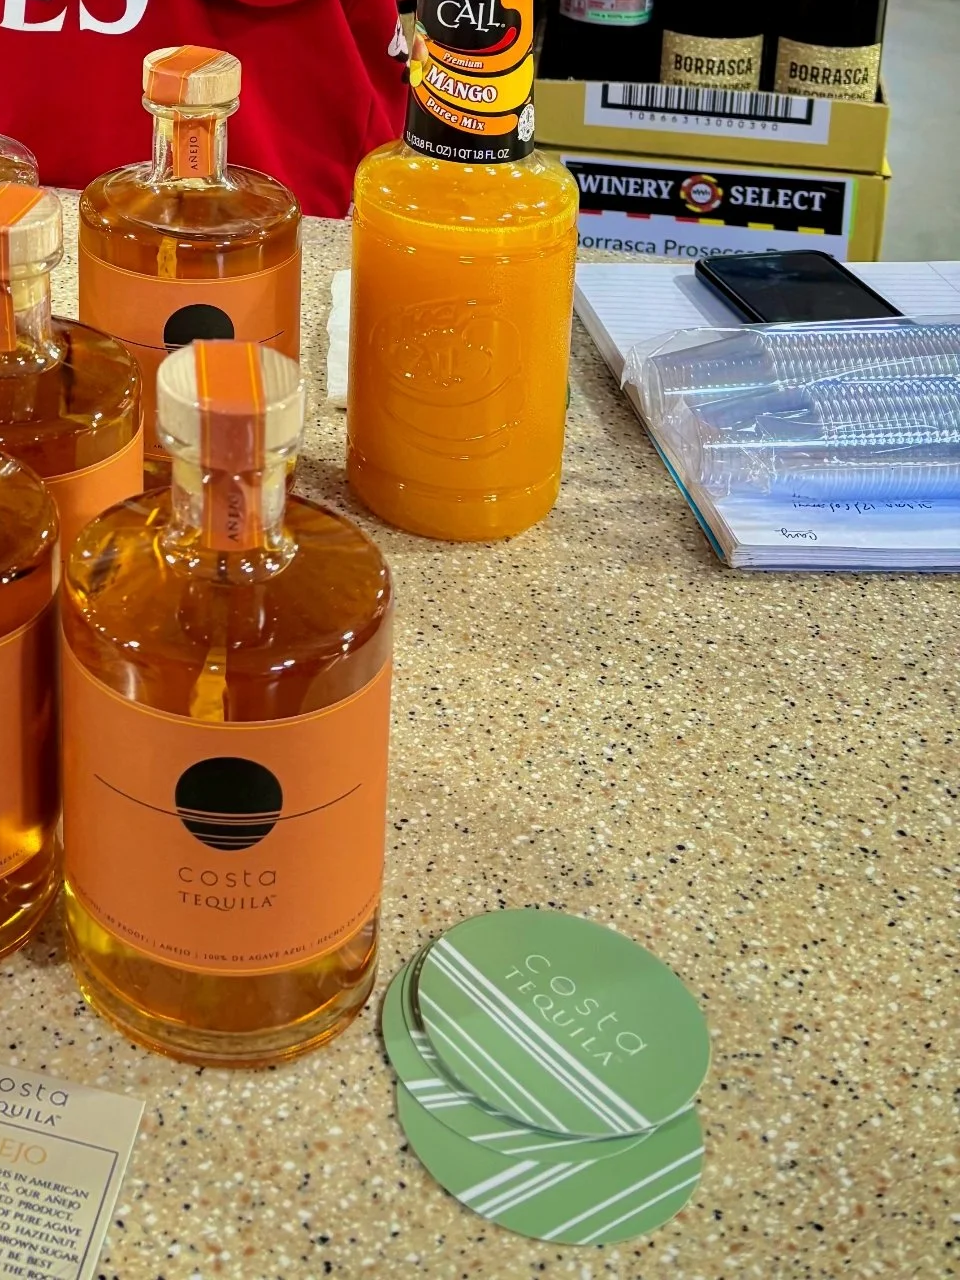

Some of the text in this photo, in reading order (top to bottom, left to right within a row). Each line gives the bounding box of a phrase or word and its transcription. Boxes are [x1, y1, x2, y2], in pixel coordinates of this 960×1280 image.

[443, 52, 483, 69] Premium
[673, 53, 753, 76] BORRASCA
[789, 61, 869, 86] BORRASCA
[425, 64, 498, 103] MANGO
[426, 97, 485, 131] Puree Mix
[189, 134, 200, 171] AÑEJO
[425, 141, 435, 153] FL
[436, 145, 452, 157] OZ)
[458, 148, 473, 159] QT
[485, 150, 496, 160] FL
[498, 149, 510, 159] OZ
[577, 173, 827, 212] WINERY SELECT
[227, 492, 241, 544] AÑEJO
[178, 867, 277, 888] costa
[178, 891, 277, 912] TEQUILA
[203, 953, 227, 962] 100%
[232, 954, 244, 962] DE
[249, 951, 280, 961] AGAVE
[504, 965, 614, 1067] TEQUILA
[524, 953, 648, 1055] costa
[13, 1172, 27, 1183] IN
[28, 1176, 89, 1199] AMERICAN
